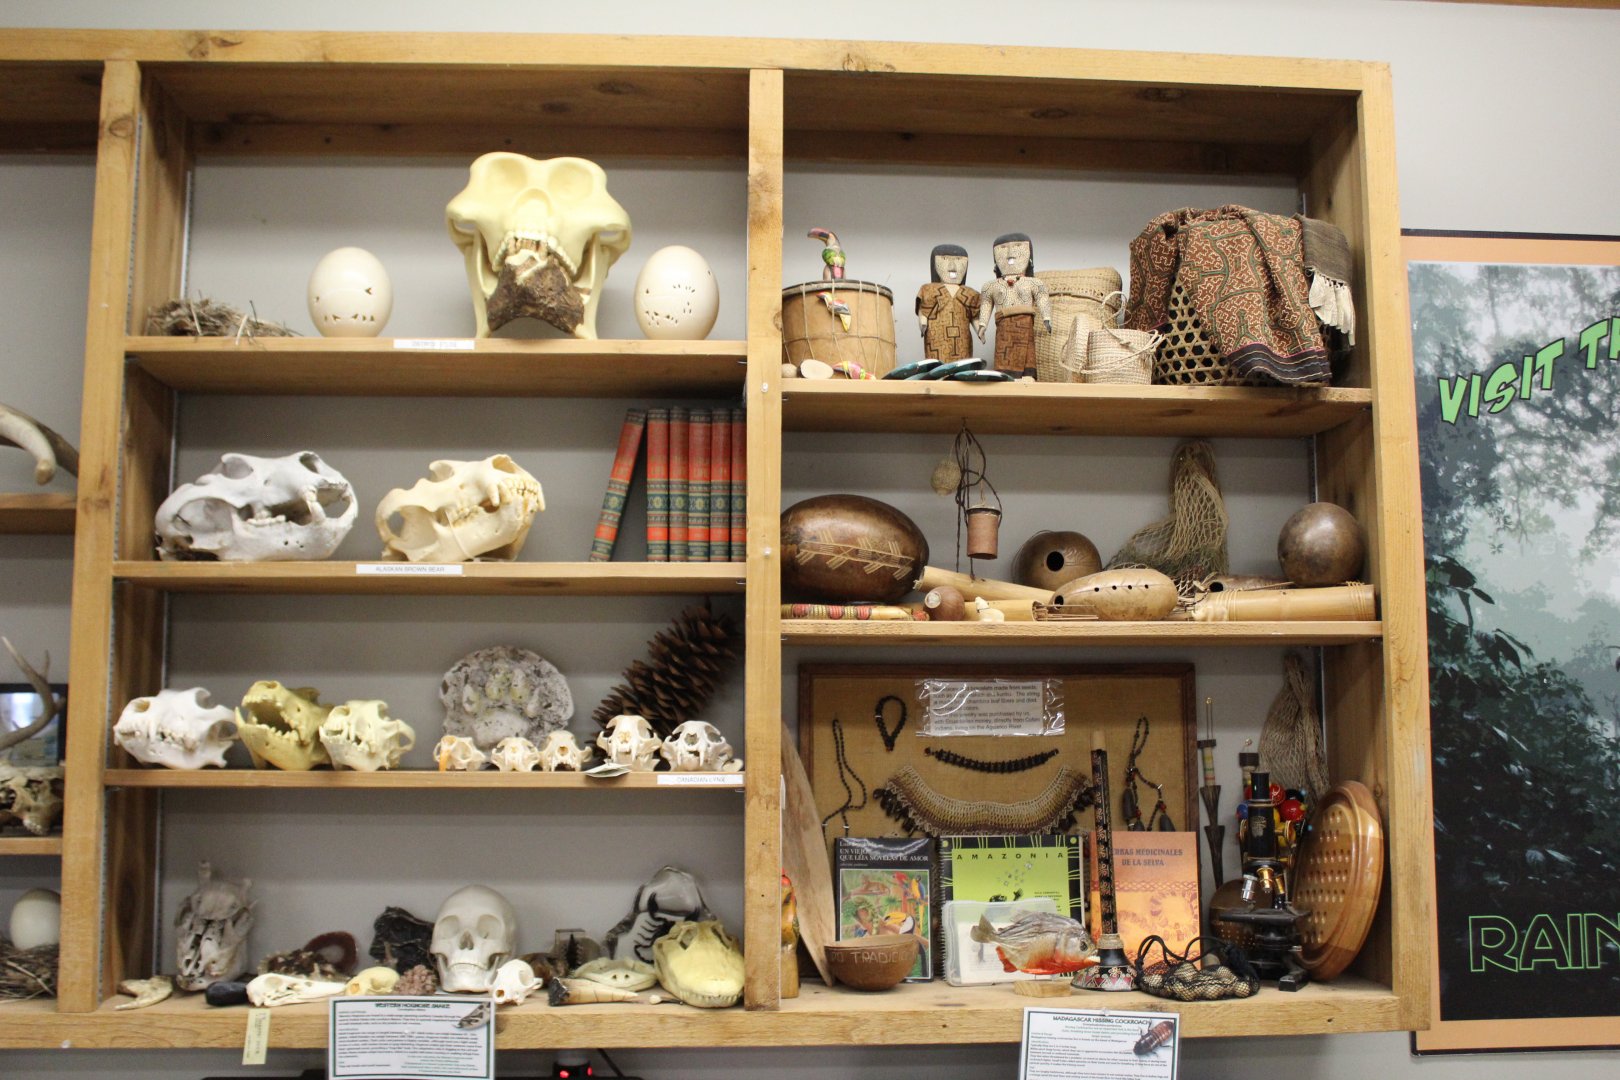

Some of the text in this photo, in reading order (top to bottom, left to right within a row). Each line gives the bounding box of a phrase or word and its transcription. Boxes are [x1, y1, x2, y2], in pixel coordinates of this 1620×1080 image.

[1438, 337, 1565, 425] VISIT
[850, 848, 868, 856] VIEJO
[956, 852, 1064, 860] AMAZONIA
[1136, 848, 1184, 857] MEDICINALES
[1122, 858, 1165, 866] DE LA SELVA
